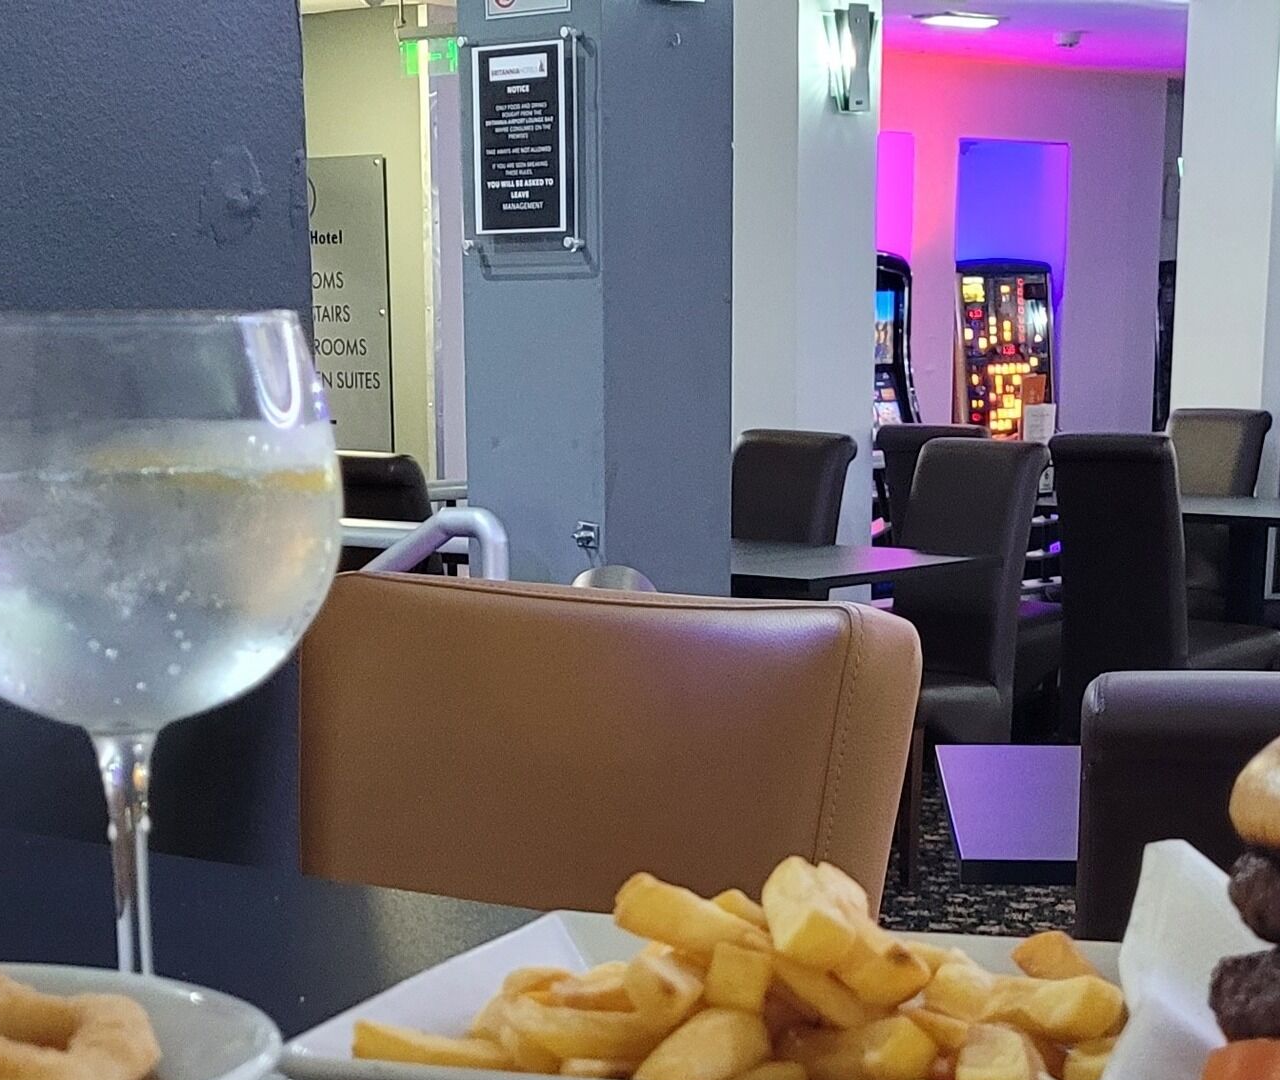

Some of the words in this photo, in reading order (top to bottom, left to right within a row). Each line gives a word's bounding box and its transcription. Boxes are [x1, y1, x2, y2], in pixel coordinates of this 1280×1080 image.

[507, 84, 530, 94] NOTICE
[487, 181, 500, 189] YOU
[501, 180, 515, 188] WILL
[524, 179, 544, 187] ASKED
[545, 178, 554, 186] TO
[510, 191, 529, 199] LEAVE
[502, 201, 544, 210] MANAGEMENT
[310, 229, 342, 245] Hotel
[312, 271, 344, 289] OMS
[313, 304, 350, 322] TAIRS
[336, 371, 381, 389] SUITES
